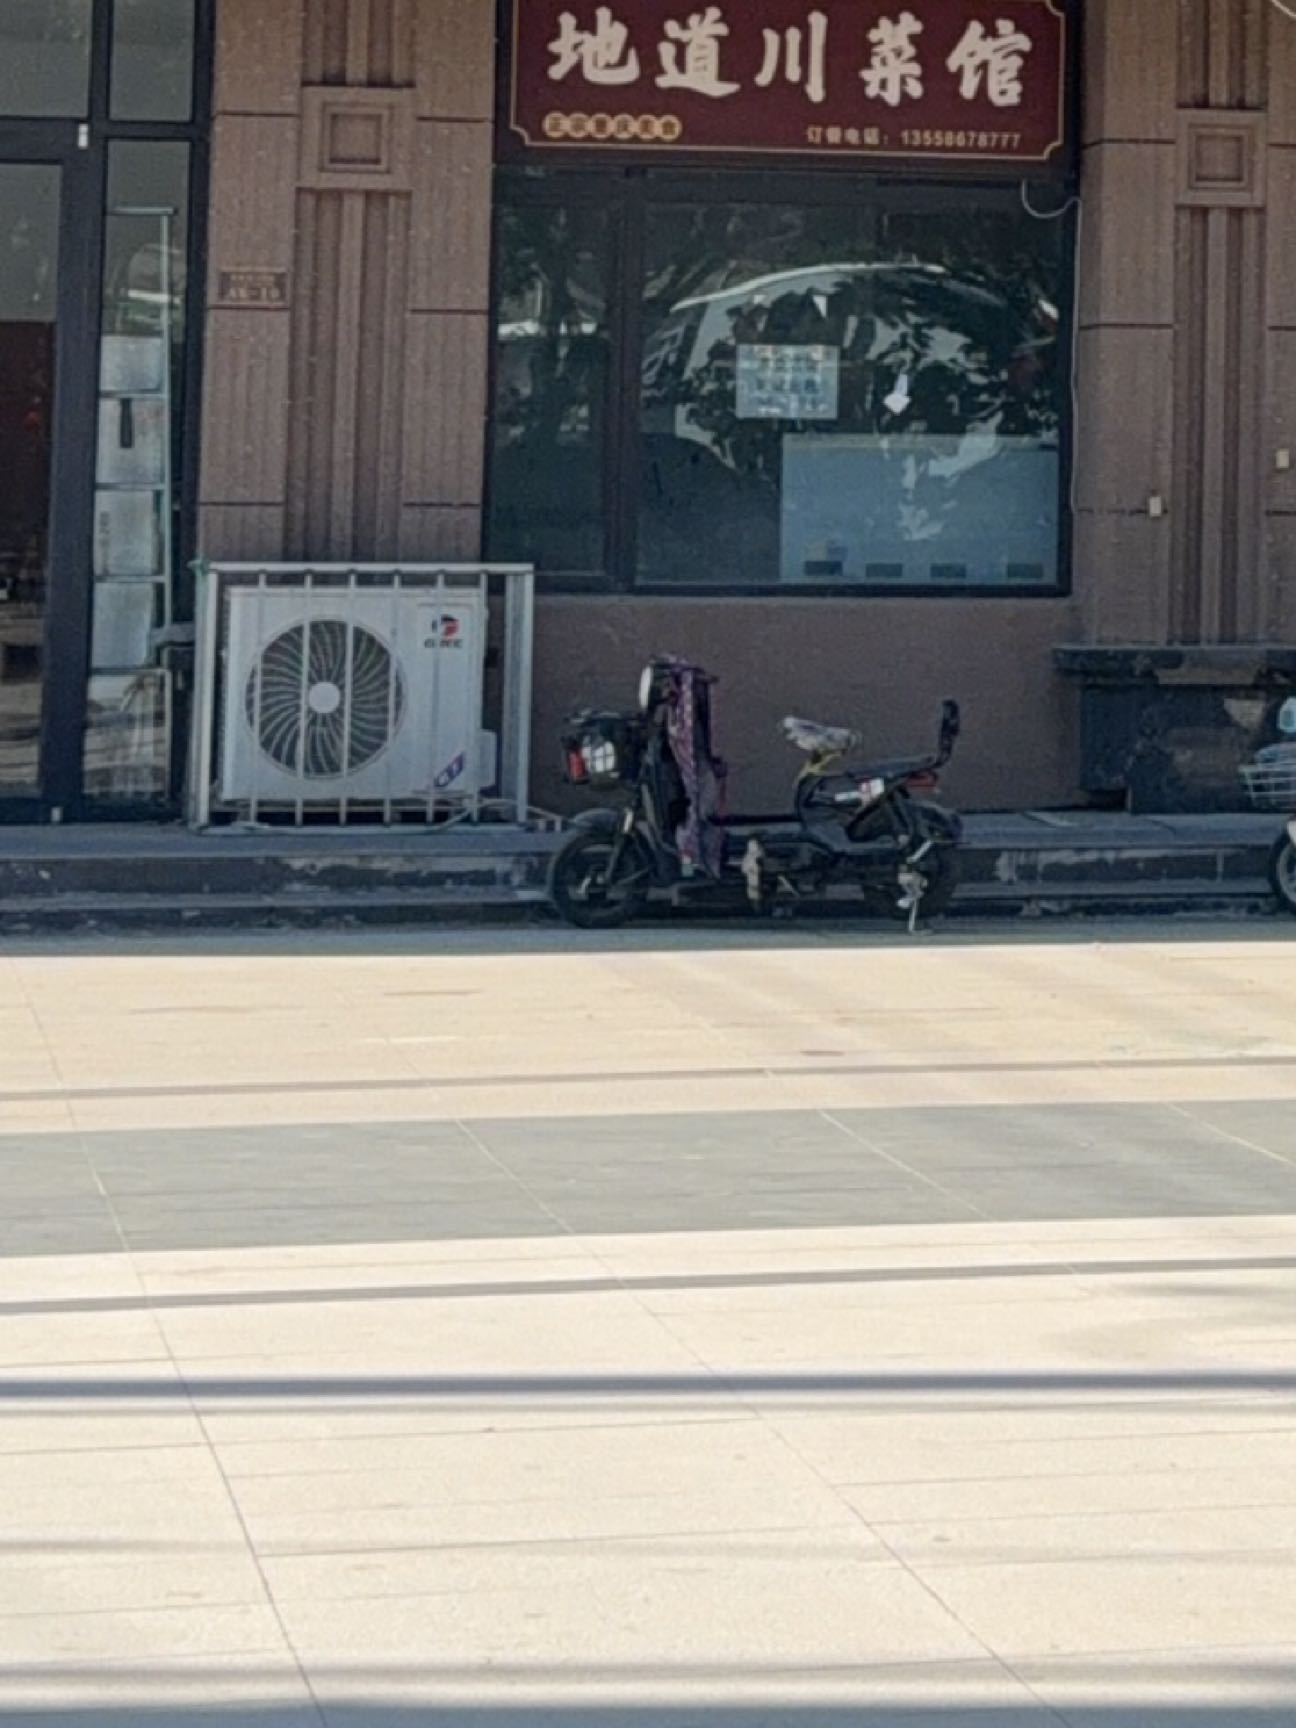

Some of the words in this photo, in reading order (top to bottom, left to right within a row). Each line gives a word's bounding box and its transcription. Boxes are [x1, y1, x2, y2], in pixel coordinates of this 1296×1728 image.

[546, 5, 1033, 108] 地道川菜馆
